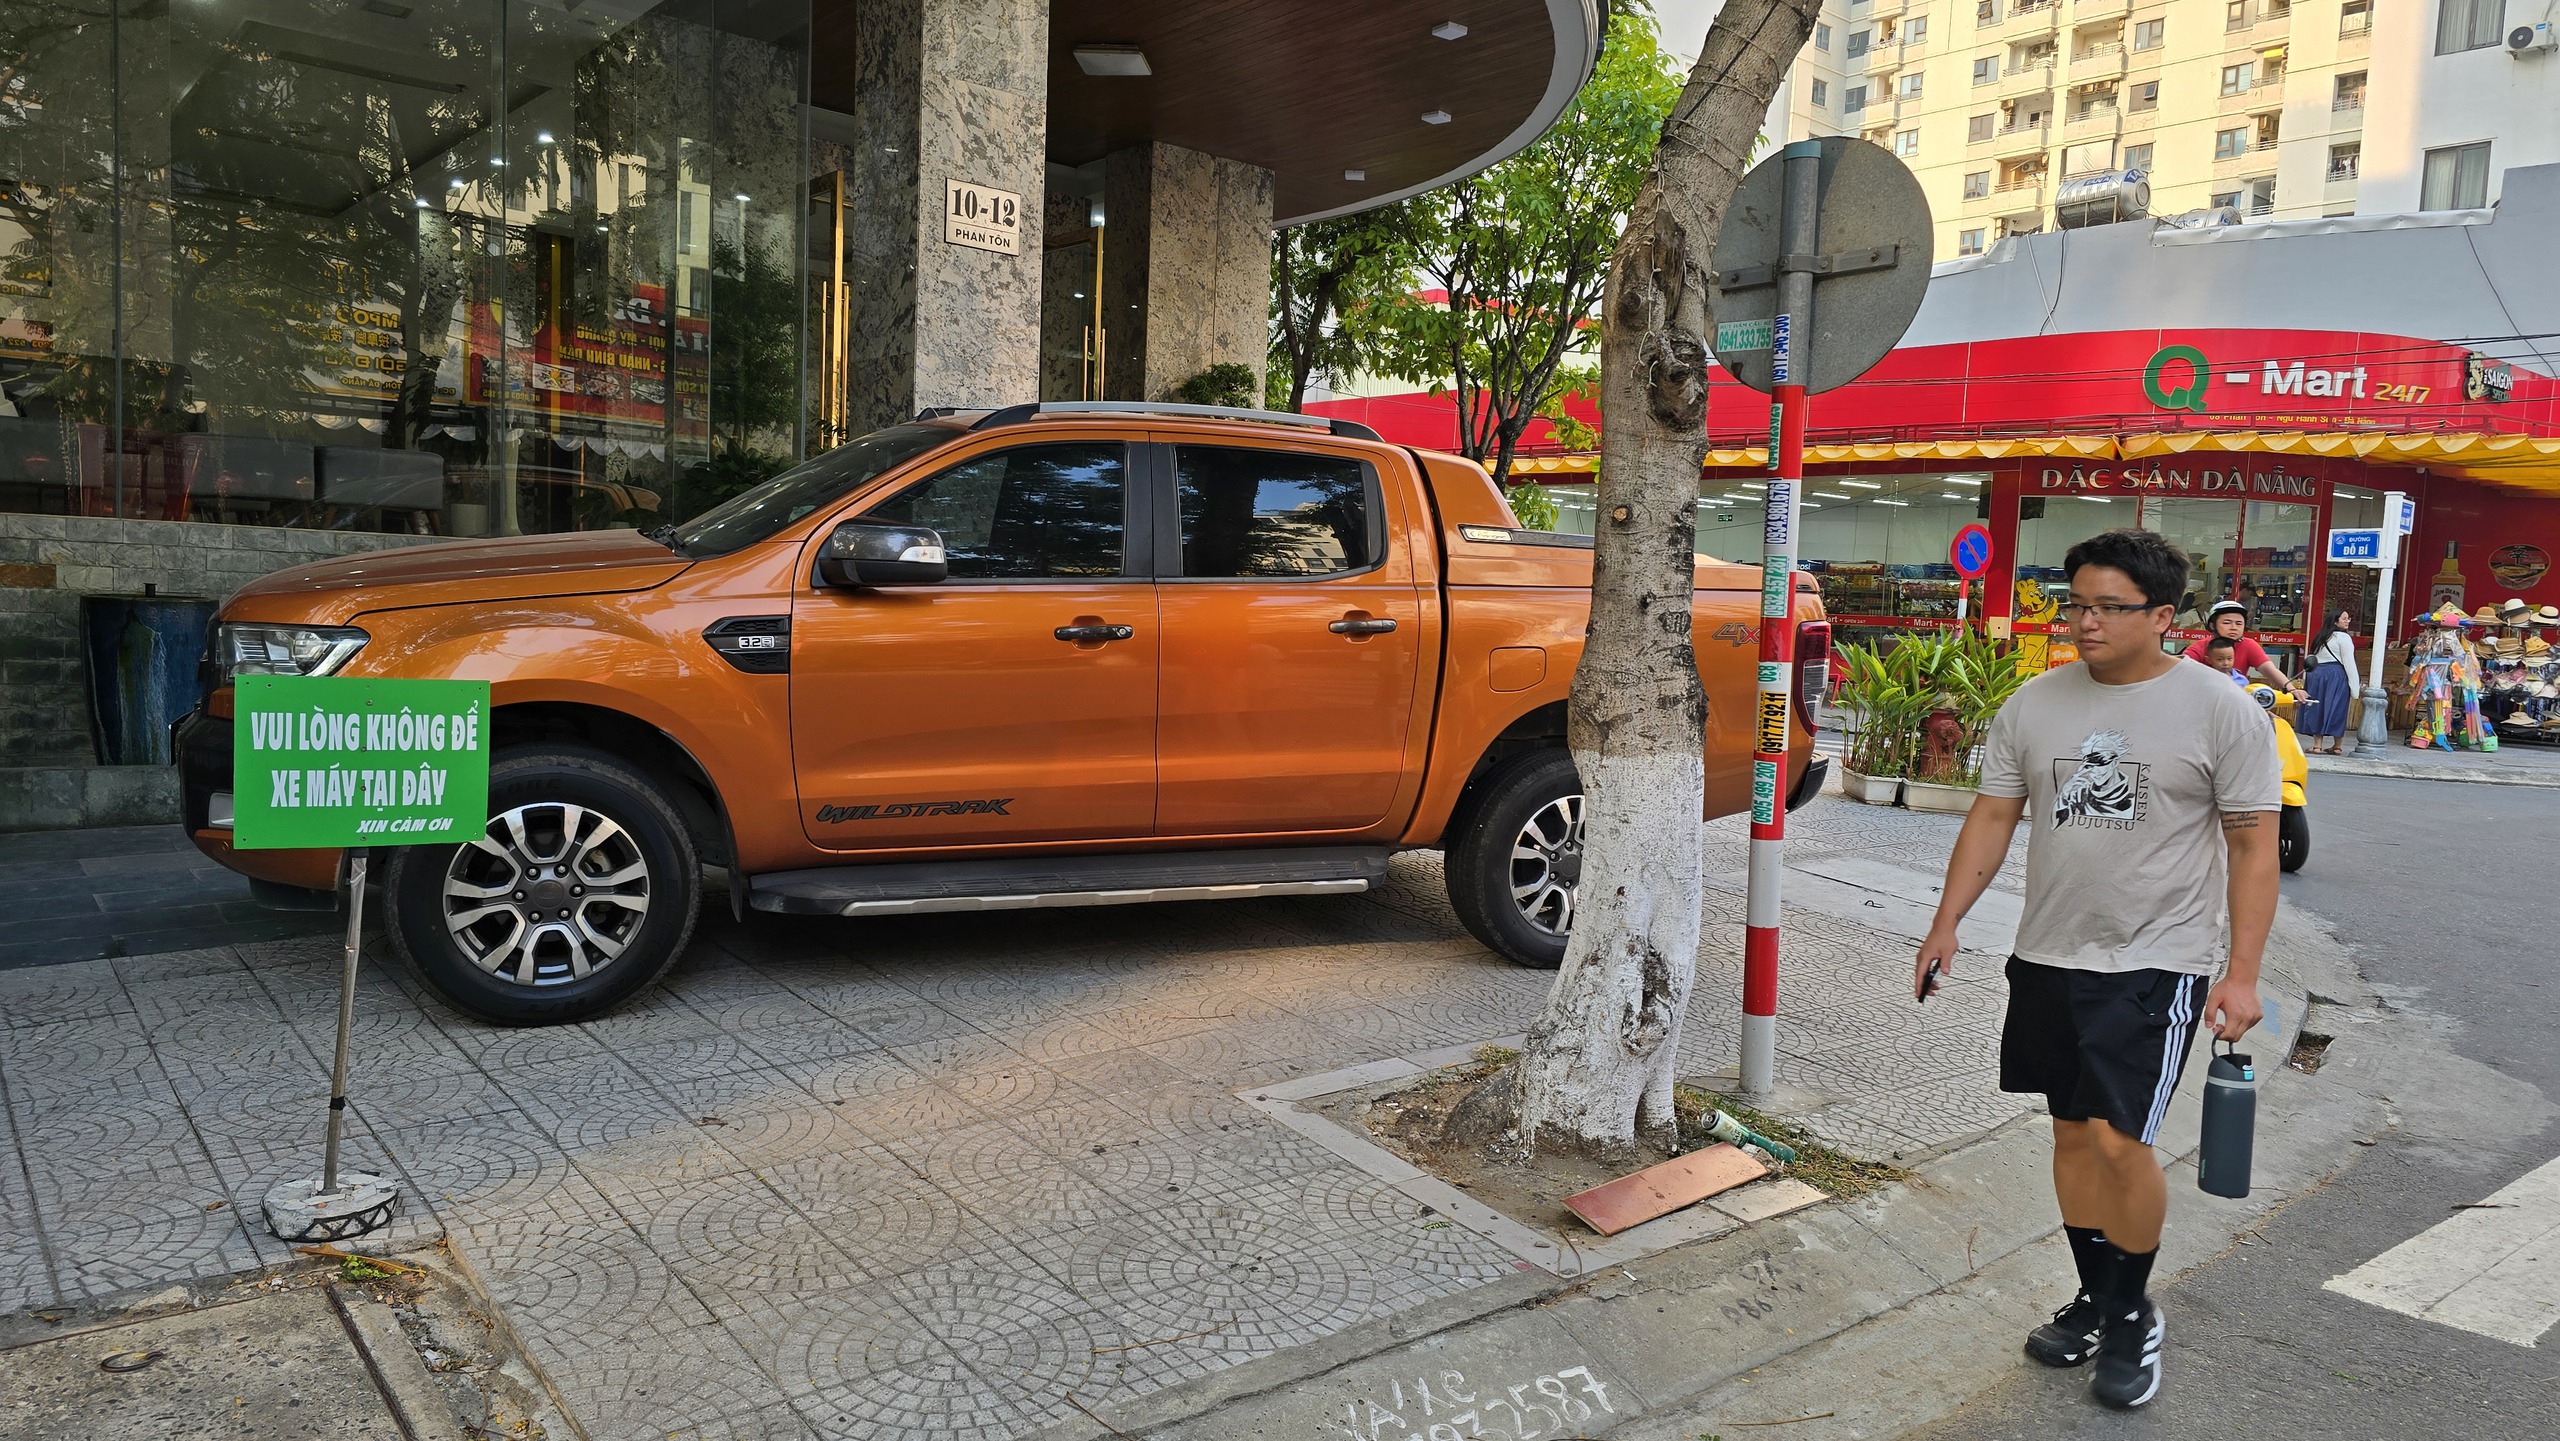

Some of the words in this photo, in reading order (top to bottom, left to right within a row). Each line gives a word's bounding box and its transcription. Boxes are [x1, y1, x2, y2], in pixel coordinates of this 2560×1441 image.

[951, 187, 1016, 228] 10-12
[955, 228, 986, 243] PHAN
[989, 234, 1011, 248] TÔN
[1719, 327, 1772, 351] 0941.333.755
[2143, 344, 2210, 412] Q
[2261, 360, 2368, 399] Mart
[2373, 382, 2431, 404] 24/7
[2488, 368, 2514, 391] SAIGON
[2121, 462, 2191, 490] SẢN
[2253, 465, 2316, 498] NẴNG
[1765, 482, 1790, 545] 0934.980.676
[2358, 544, 2368, 555] BÍ
[1764, 556, 1788, 616] 0932.557.287
[2433, 589, 2445, 597] JIM
[2445, 587, 2460, 597] BEAM
[1826, 615, 1838, 623] art
[1914, 618, 1932, 627] Mart
[2163, 629, 2184, 638] Mart
[2260, 633, 2274, 642] Mart
[251, 711, 293, 750] VUI
[299, 704, 360, 751] LÒNG
[366, 705, 446, 751] KHÔNG
[451, 699, 479, 751] ĐỂ
[1761, 692, 1787, 753] 0917.77.92.11
[270, 769, 300, 807] XE
[305, 761, 357, 807] MÁY
[361, 769, 397, 812] TẠI
[402, 761, 447, 806] ĐÂY
[1752, 761, 1776, 823] 0905.499.200
[2136, 763, 2152, 822] KAISEN
[815, 798, 1016, 824] WILDTRAK
[2068, 815, 2136, 831] JUJUTSU
[355, 819, 388, 834] XIN
[390, 815, 427, 832] CẢM
[428, 816, 454, 831] ƠN
